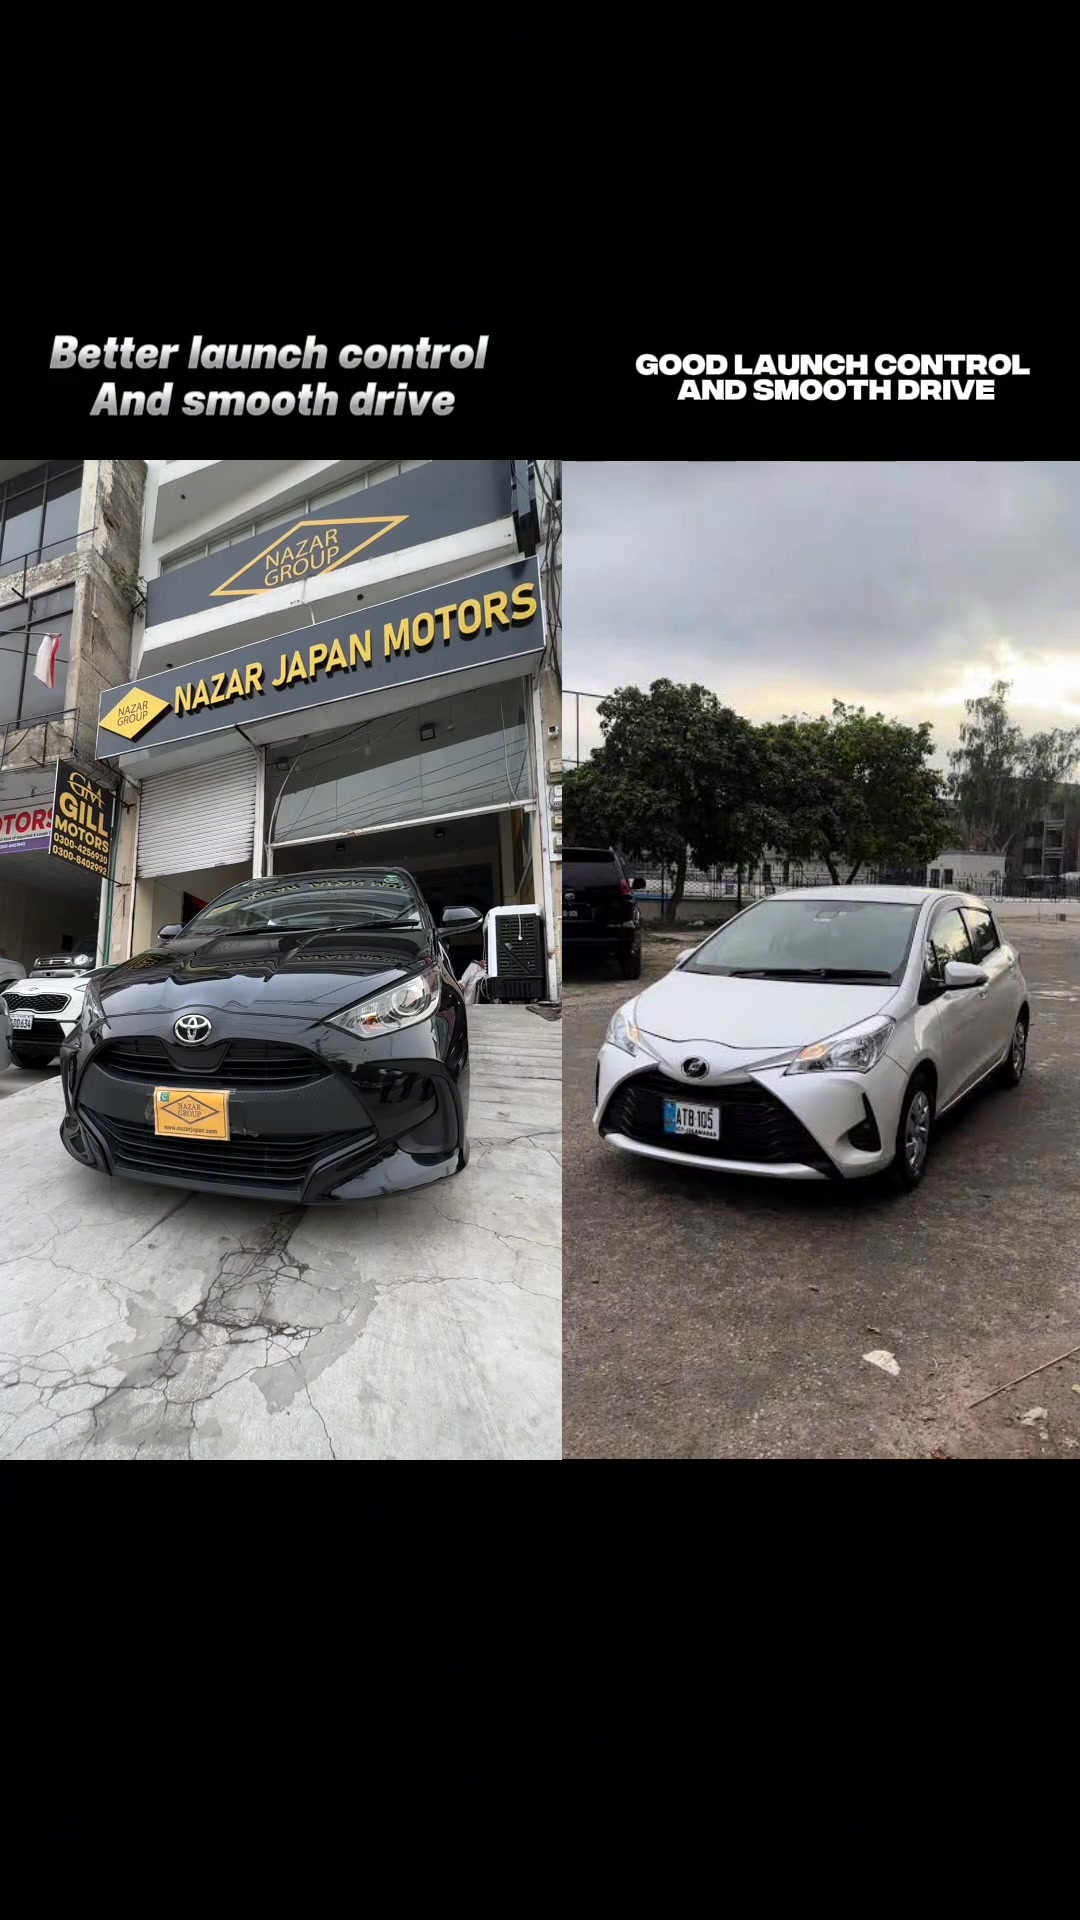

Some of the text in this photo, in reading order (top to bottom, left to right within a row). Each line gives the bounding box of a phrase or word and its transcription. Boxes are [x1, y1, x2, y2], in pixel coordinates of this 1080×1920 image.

[265, 528, 338, 570] NAZAR
[264, 546, 340, 586] GROUP
[174, 582, 538, 714] NAZAR JAPAN MOTORS
[117, 711, 149, 727] GROUP
[118, 701, 149, 717] NAZAR
[60, 792, 108, 837] GILL
[55, 815, 109, 853] MOTORS
[53, 845, 107, 876] 0300-8402992
[177, 1110, 202, 1118] GROUP
[178, 1103, 201, 1111] NAZAR
[164, 1125, 218, 1134] www.nazarjapan.com
